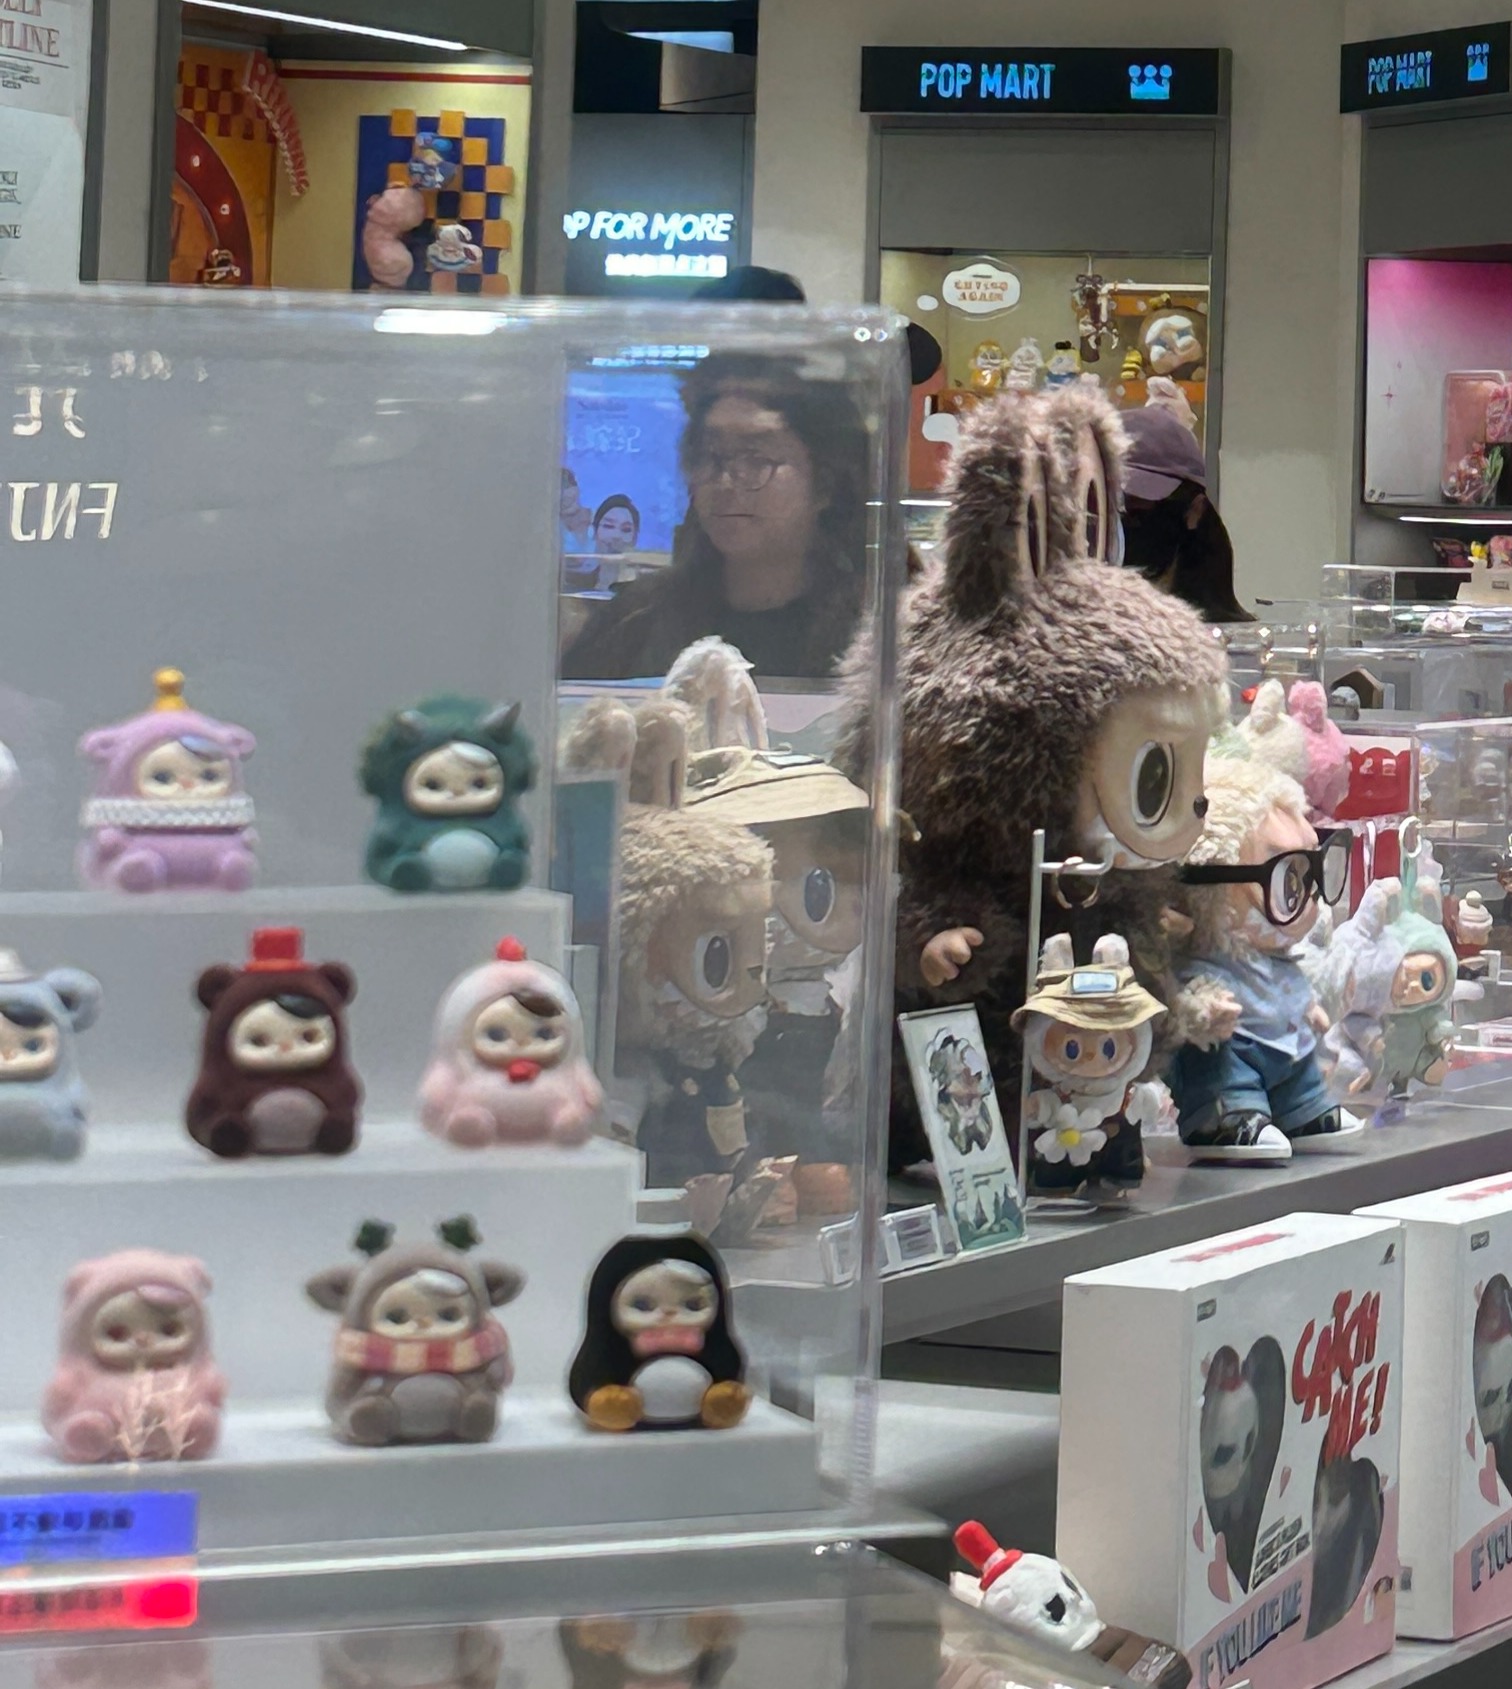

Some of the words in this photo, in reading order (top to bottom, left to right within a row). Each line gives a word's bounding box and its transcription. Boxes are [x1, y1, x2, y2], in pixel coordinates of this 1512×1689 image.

[920, 63, 973, 98] POP
[980, 63, 1056, 99] MART
[1368, 56, 1395, 95] POP
[590, 211, 649, 240] FOR
[650, 212, 734, 250] MORE
[1291, 1289, 1380, 1424] CATCH
[1323, 1361, 1390, 1467] ME!
